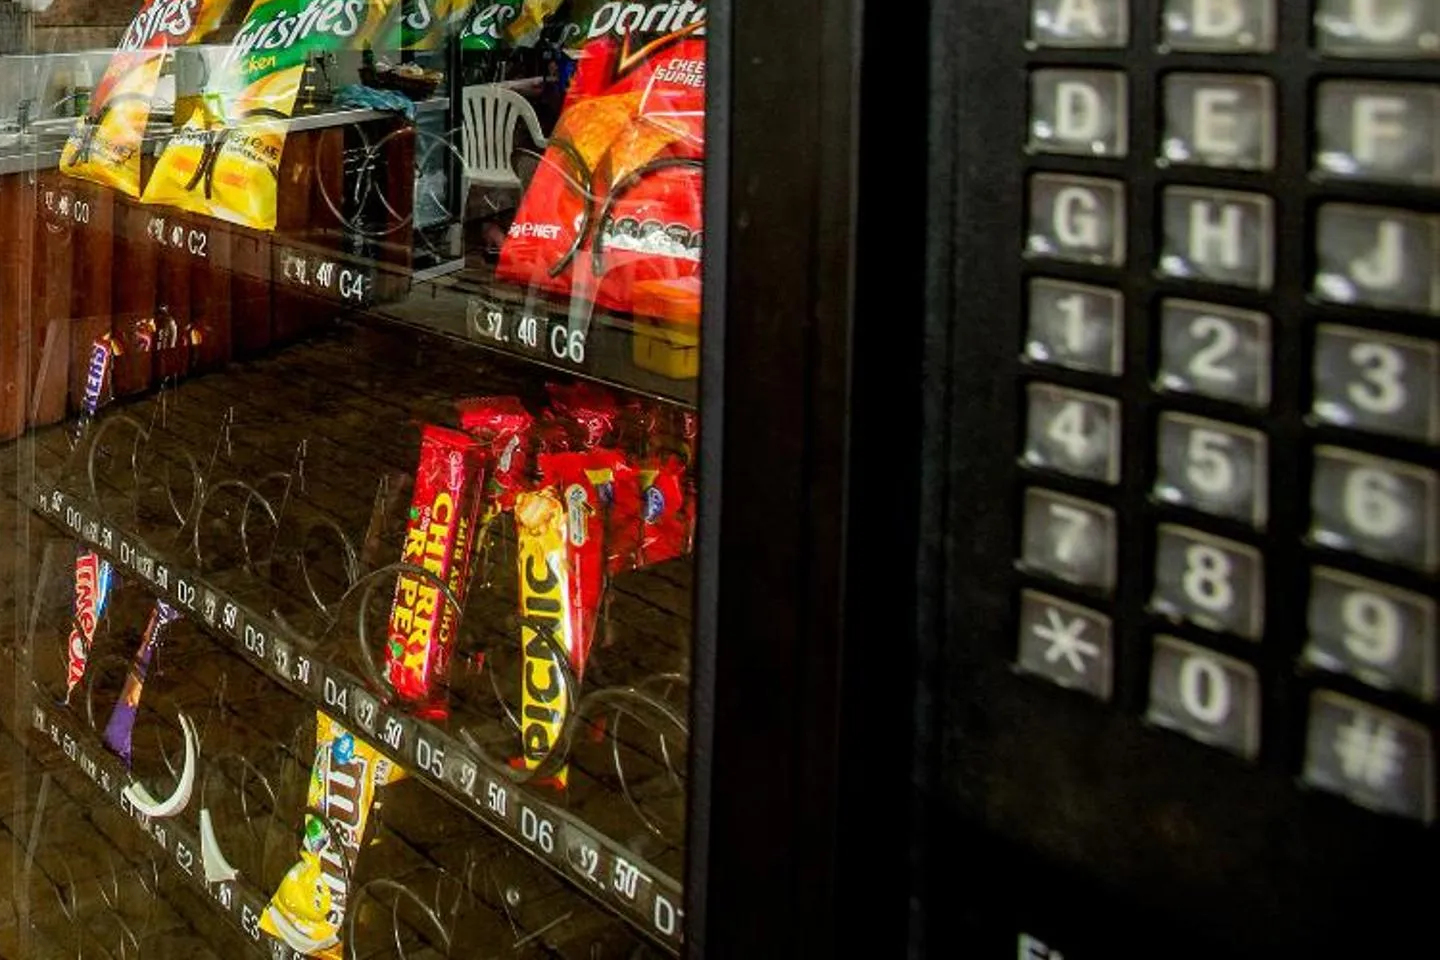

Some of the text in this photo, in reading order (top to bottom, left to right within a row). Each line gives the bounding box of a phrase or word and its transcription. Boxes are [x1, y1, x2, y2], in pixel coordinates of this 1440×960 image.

[655, 69, 706, 87] SUPRE
[669, 59, 706, 73] CHEE
[1055, 82, 1408, 162] D E F
[188, 229, 207, 257] C2
[1052, 187, 1403, 288] G H J
[339, 269, 363, 301] C4
[550, 324, 586, 364] C6
[1056, 295, 1405, 412] 1 2 3
[1048, 401, 1405, 538] 4 5 6
[177, 579, 196, 611] D2
[394, 527, 427, 633] RPE
[1049, 504, 1402, 665] 7 8 9
[245, 624, 265, 658] D3
[523, 553, 561, 762] PICNIC
[324, 678, 349, 715] D4
[1179, 655, 1230, 725] 0
[417, 739, 445, 778] D5
[521, 807, 554, 854] D6
[654, 894, 684, 936] D
